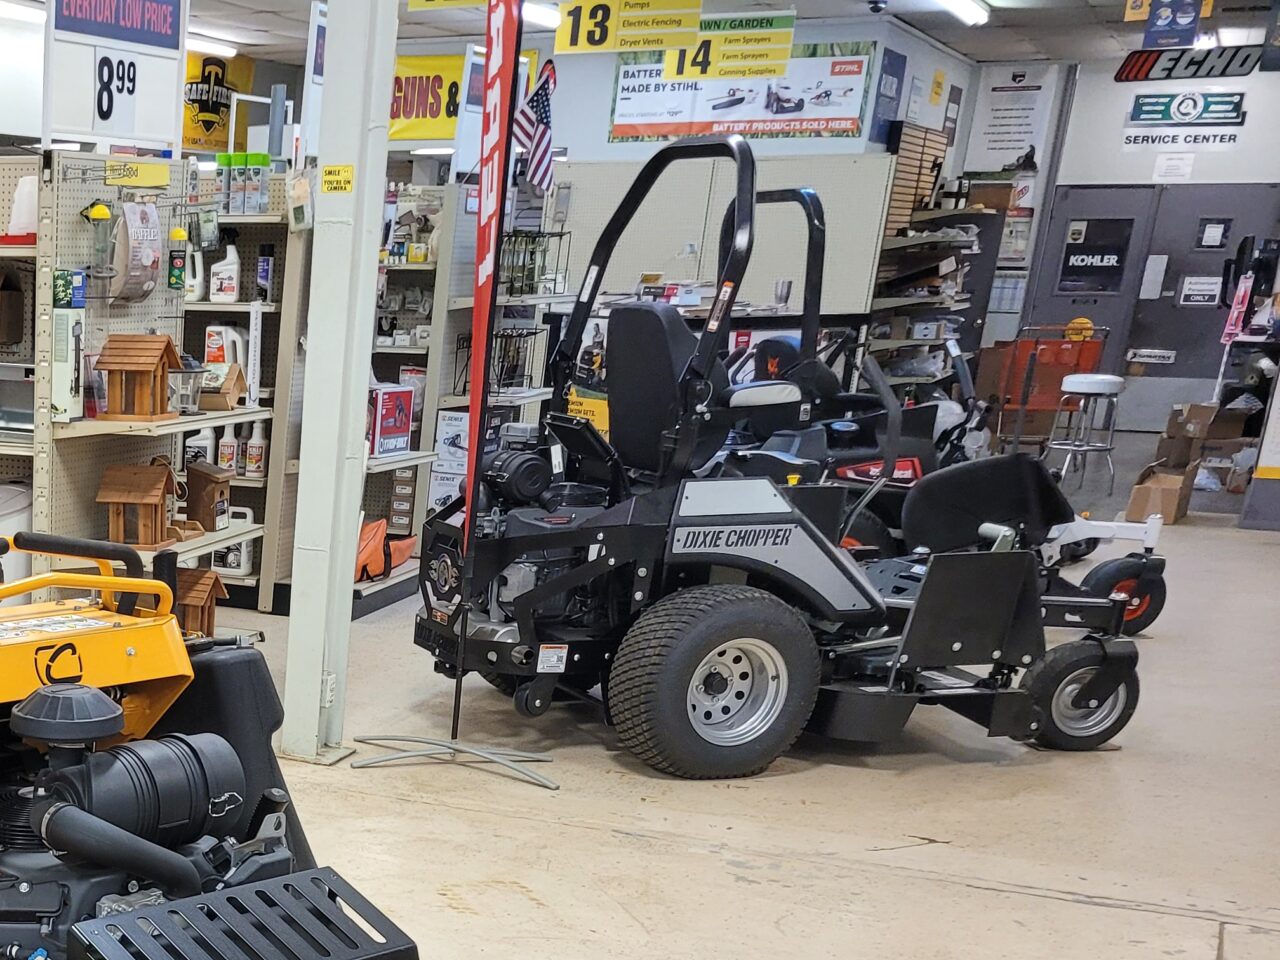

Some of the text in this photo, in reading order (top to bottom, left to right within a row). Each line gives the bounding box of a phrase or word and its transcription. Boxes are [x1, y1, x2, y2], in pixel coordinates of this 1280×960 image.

[624, 1, 650, 9] Pumps
[120, 0, 141, 30] LOW
[144, 3, 173, 35] PRICE
[623, 18, 682, 27] Electric Fencing
[567, 4, 611, 46] 13
[729, 18, 774, 29] GARDEN
[620, 37, 663, 47] Dryer Vents
[743, 36, 771, 44] Sprayers
[676, 40, 712, 75] 14
[740, 52, 768, 60] Sprayers
[833, 64, 860, 72] STIHL
[1148, 46, 1263, 79] ECHO
[623, 69, 663, 79] BATTER
[621, 82, 703, 94] MADE BY STIHL.
[390, 75, 443, 119] GUNS
[712, 122, 750, 131] BATTERY
[752, 120, 800, 131] PRODUCTS
[802, 119, 826, 129] SOLD
[1124, 134, 1237, 144] SERVICE CENTER
[1069, 255, 1118, 266] KOHLER
[682, 528, 792, 549] DIXIE CHOPPER
